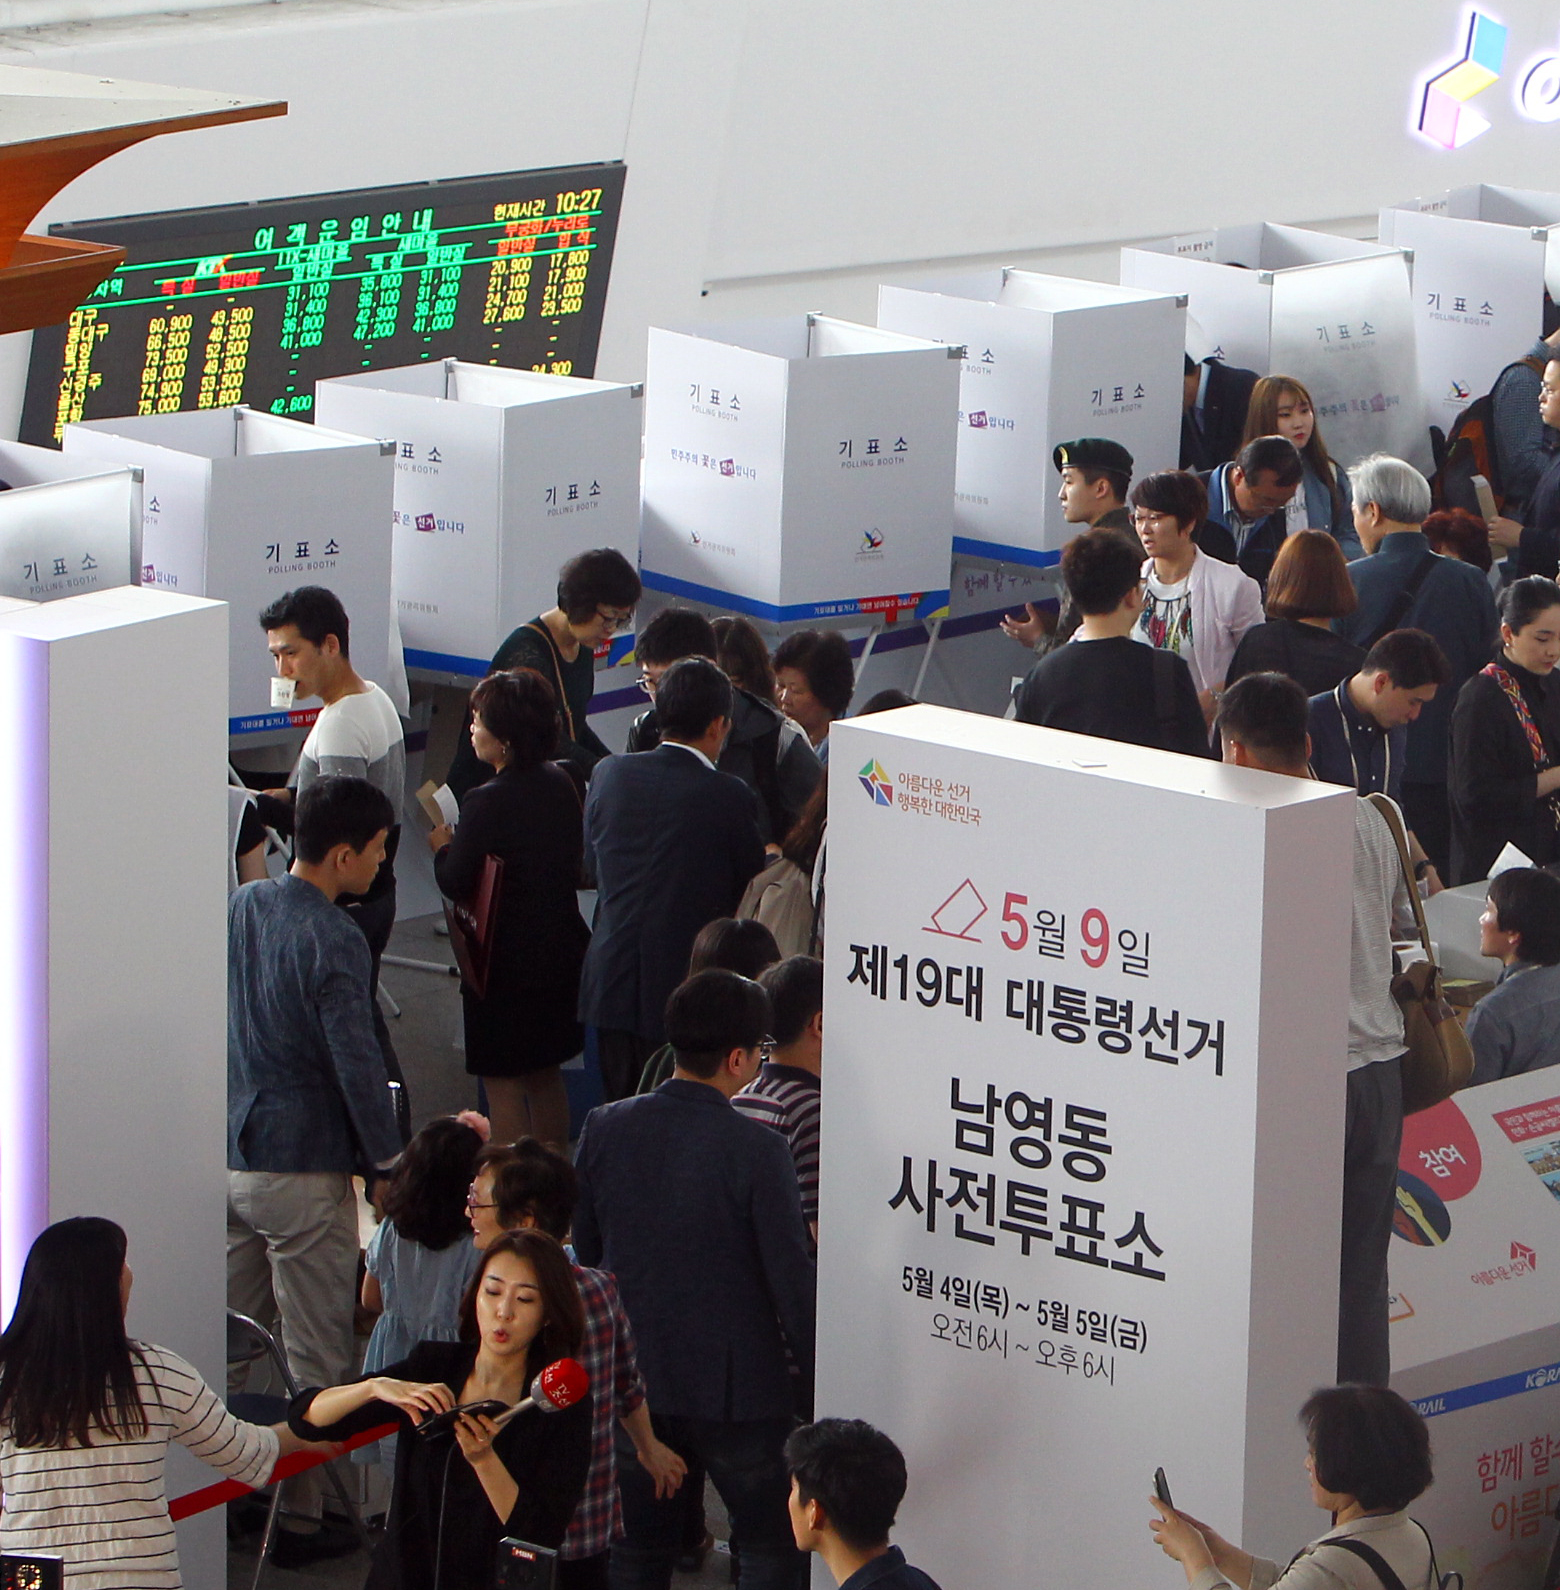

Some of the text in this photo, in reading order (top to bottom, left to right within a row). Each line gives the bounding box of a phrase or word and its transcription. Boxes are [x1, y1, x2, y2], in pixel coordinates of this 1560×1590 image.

[494, 188, 603, 221] 현재시간 10:27
[491, 257, 532, 275] 20,900
[550, 250, 590, 269] 17,800
[360, 274, 403, 293] 35,800
[420, 266, 462, 285] 31,100
[488, 274, 530, 292] 21,100
[547, 266, 587, 286] 17,900
[287, 282, 330, 301] 31,100
[358, 290, 400, 309] 36,100
[416, 282, 459, 302] 31,400
[485, 290, 527, 309] 24,700
[543, 282, 585, 301] 21,000
[211, 306, 254, 325] 43,500
[284, 297, 327, 317] 31,400
[355, 306, 397, 325] 42,300
[415, 299, 456, 318] 36,800
[483, 306, 525, 325] 27,600
[541, 298, 582, 318] 23,500
[69, 308, 98, 327] 대구
[149, 314, 193, 334] 60,900
[282, 314, 325, 333] 36,800
[412, 314, 454, 333] 41,000
[208, 323, 251, 342] 48,500
[280, 331, 322, 350] 41,000
[353, 321, 395, 341] 47,200
[146, 331, 191, 351] 66,500
[206, 339, 249, 359] 52,500
[145, 347, 188, 367] 79,500
[203, 355, 246, 375] 49,300
[142, 364, 186, 384] 69,000
[201, 372, 244, 391] 53,500
[140, 380, 183, 399] 74,900
[198, 388, 241, 407] 53,600
[138, 397, 181, 416] 75,000
[270, 395, 313, 414] 42,600
[691, 405, 738, 422] POLLING BOOTH
[412, 465, 439, 476] BOOTH
[841, 456, 905, 469] POLLING BOOTH
[547, 501, 598, 517] POLLING BOOTH
[268, 560, 336, 574] POLLING BOOTH
[29, 575, 97, 595] POLLING BOOTH
[898, 772, 971, 802] 아름다운 선거
[897, 791, 982, 826] 행복한 대한민국
[1001, 892, 1150, 978] 5월 9일
[847, 943, 1225, 1077] 제19대 대통령선거
[951, 1077, 1112, 1182] 남영동
[1417, 1142, 1467, 1177] 참여
[888, 1155, 1166, 1282] 사전투표소
[1471, 1260, 1533, 1286] 아름다운 선거
[902, 1266, 934, 1300] 5월
[940, 1275, 1010, 1319] 4일(목)
[1037, 1301, 1070, 1334] 5월
[1076, 1309, 1148, 1354] 5일(금)
[1477, 1442, 1524, 1494] 함께
